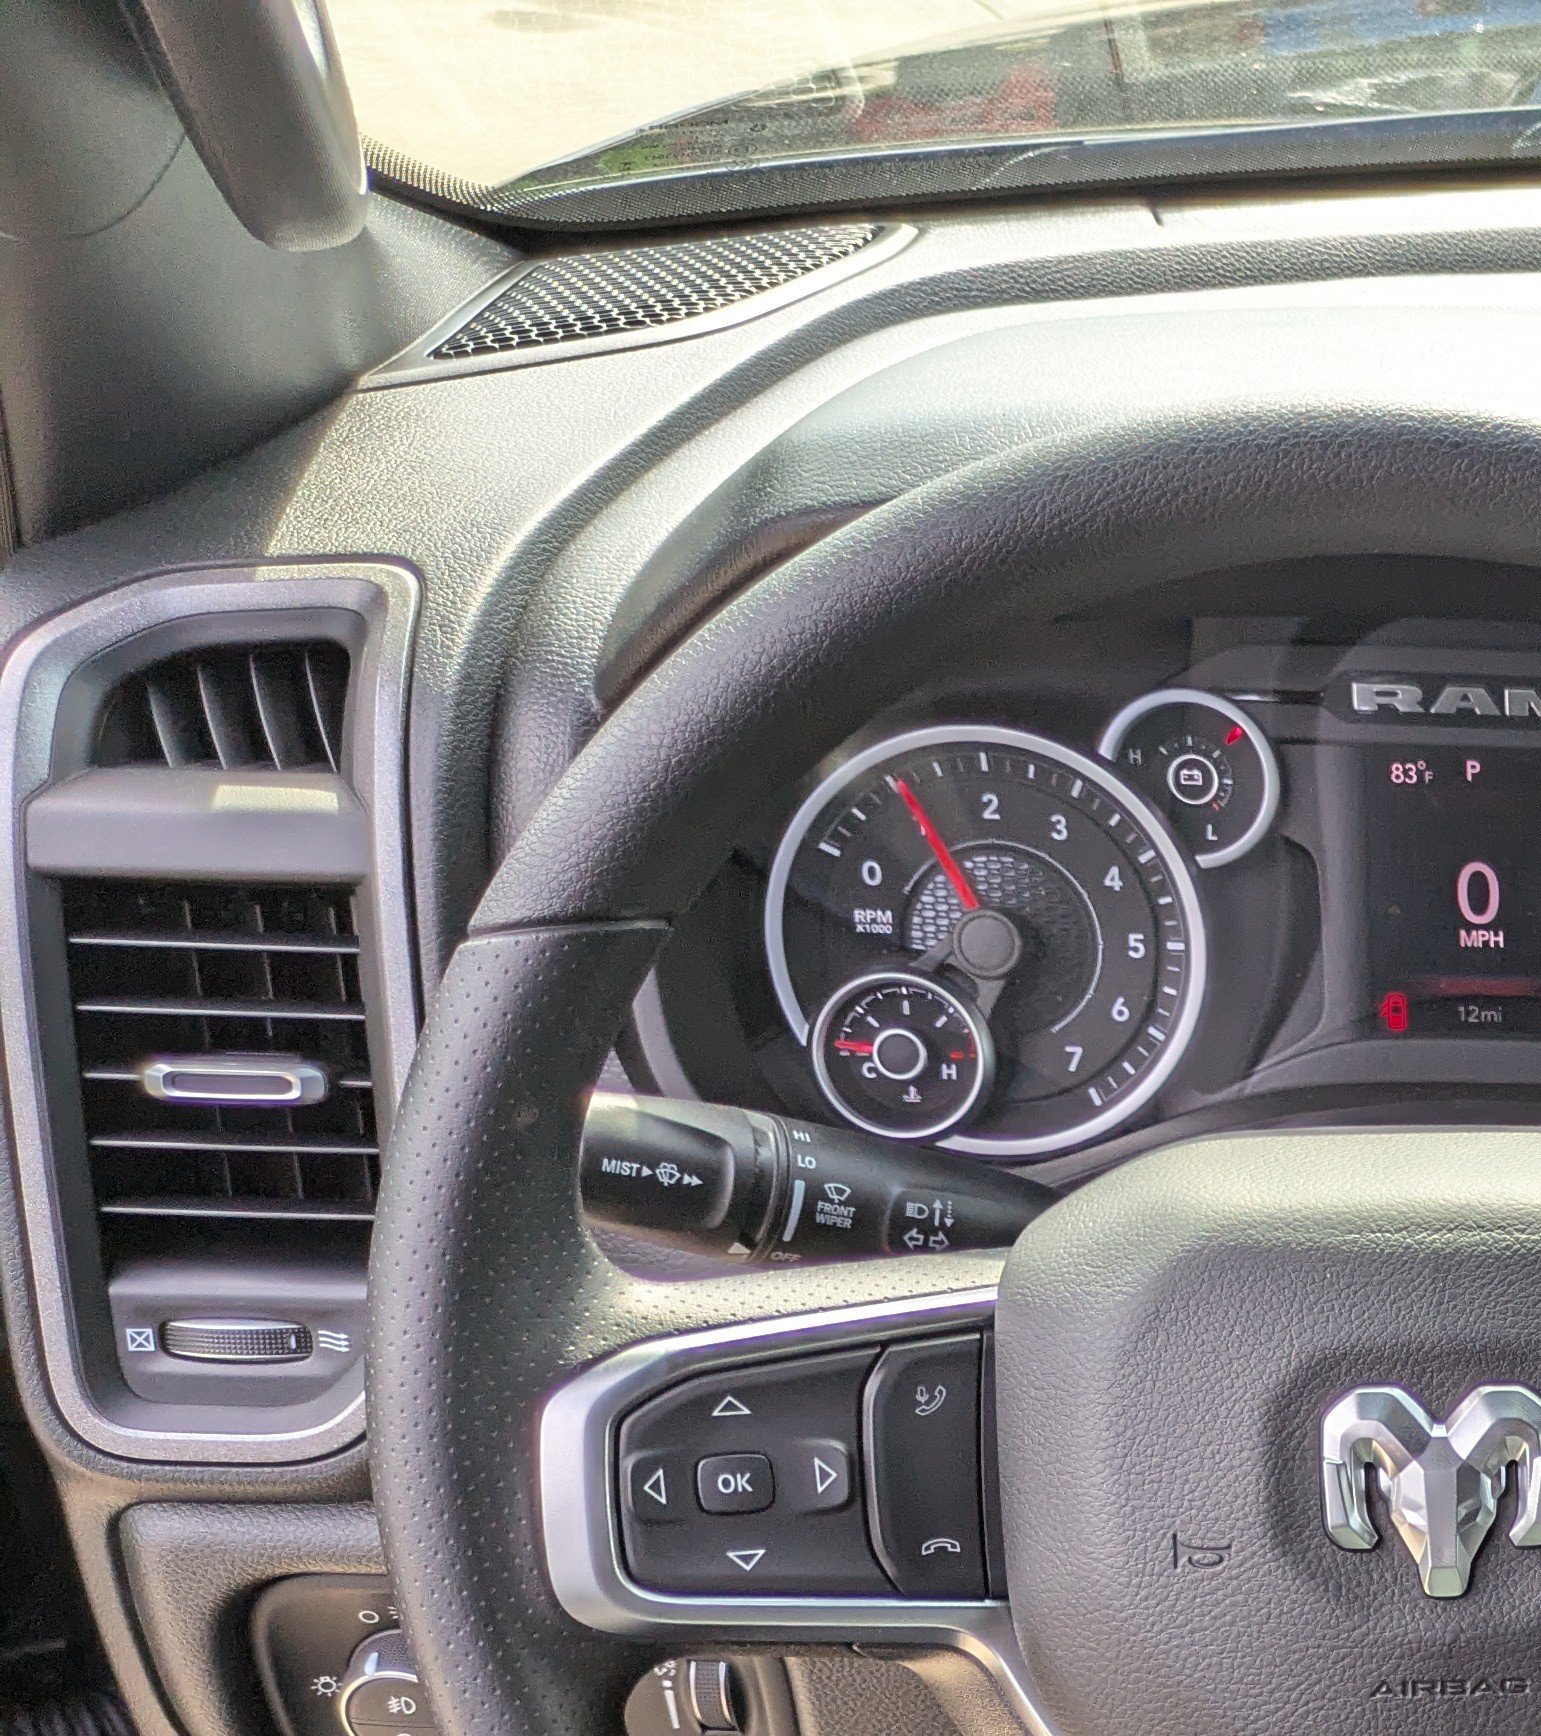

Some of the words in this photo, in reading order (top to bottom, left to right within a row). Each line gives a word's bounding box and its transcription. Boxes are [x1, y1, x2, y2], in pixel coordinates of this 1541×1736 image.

[1466, 760, 1480, 781] P
[982, 795, 1001, 819] 2
[1050, 817, 1067, 841] 3
[861, 862, 883, 886] 0
[1103, 865, 1124, 891] 4
[1456, 861, 1499, 925] 0
[853, 910, 893, 924] RPM
[1128, 934, 1145, 958] 5
[1459, 930, 1504, 948] MPH
[1111, 998, 1130, 1021] 6
[1066, 1047, 1083, 1073] 7
[862, 1063, 877, 1080] C
[942, 1063, 957, 1080] H
[792, 1130, 811, 1143] HI
[601, 1158, 642, 1177] MIST
[797, 1154, 817, 1170] LO
[817, 1201, 856, 1217] FRONT
[816, 1213, 852, 1229] WIPER
[717, 1472, 753, 1494] OK
[1369, 1677, 1532, 1699] AIRBAG
